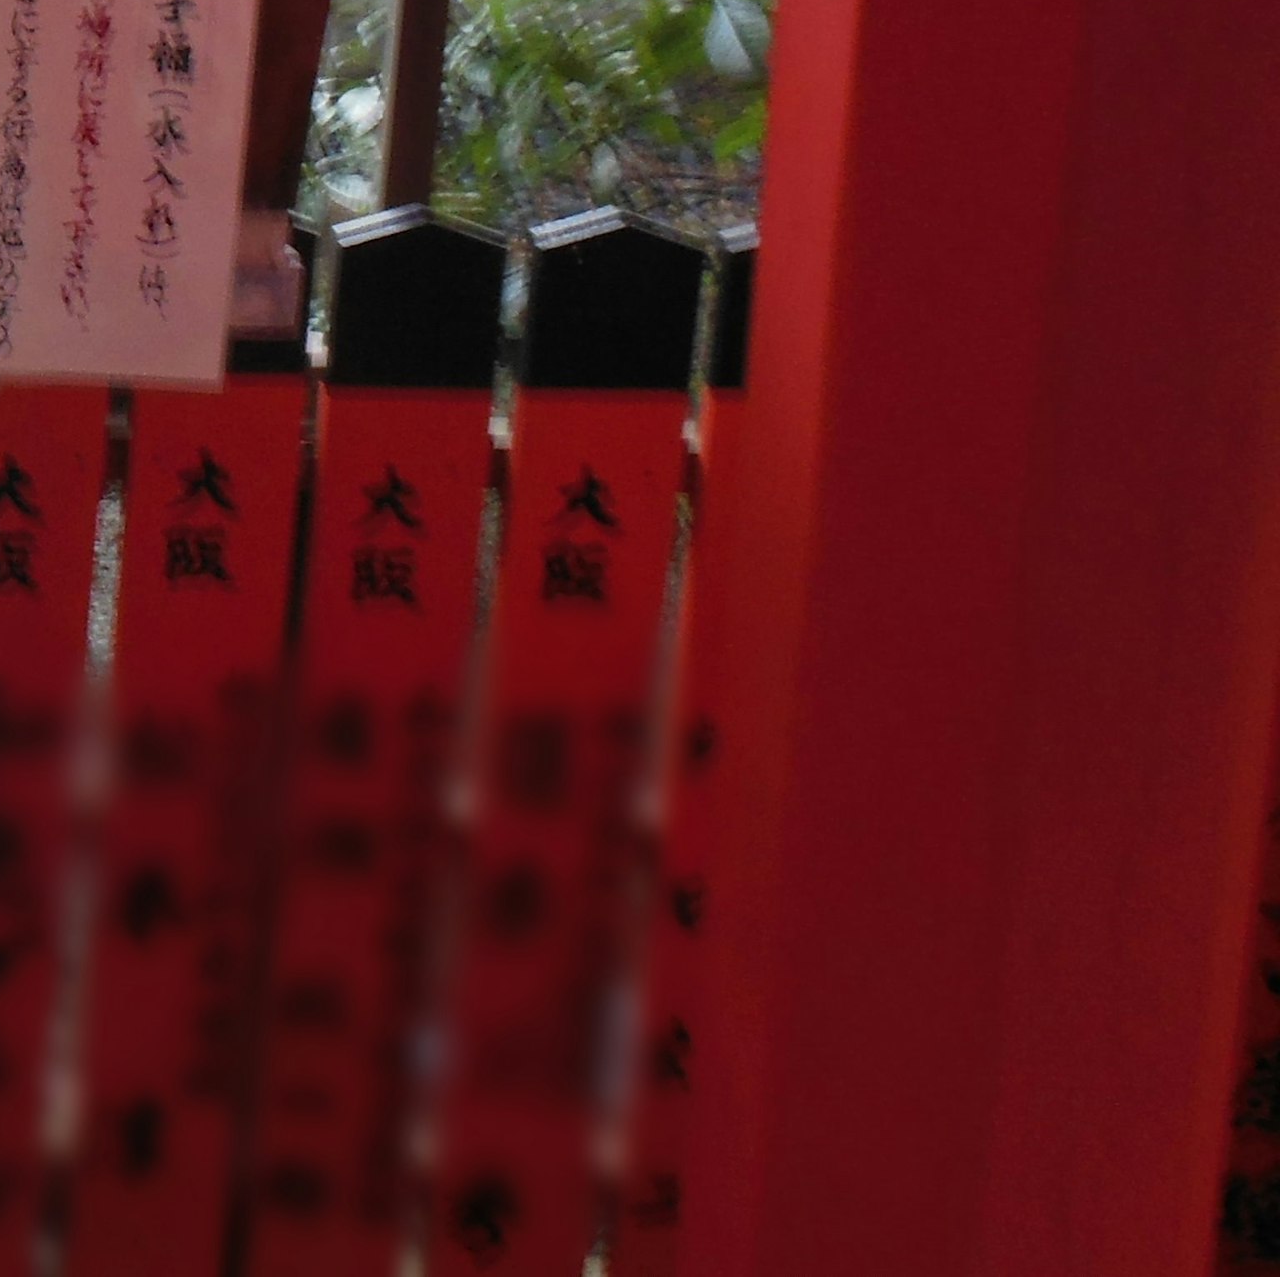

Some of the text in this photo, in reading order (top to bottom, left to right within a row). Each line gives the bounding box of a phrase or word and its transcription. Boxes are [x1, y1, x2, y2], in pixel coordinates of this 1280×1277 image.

[161, 446, 239, 590] 大阪
[346, 463, 426, 611] 大阪
[538, 462, 623, 608] 大阪
